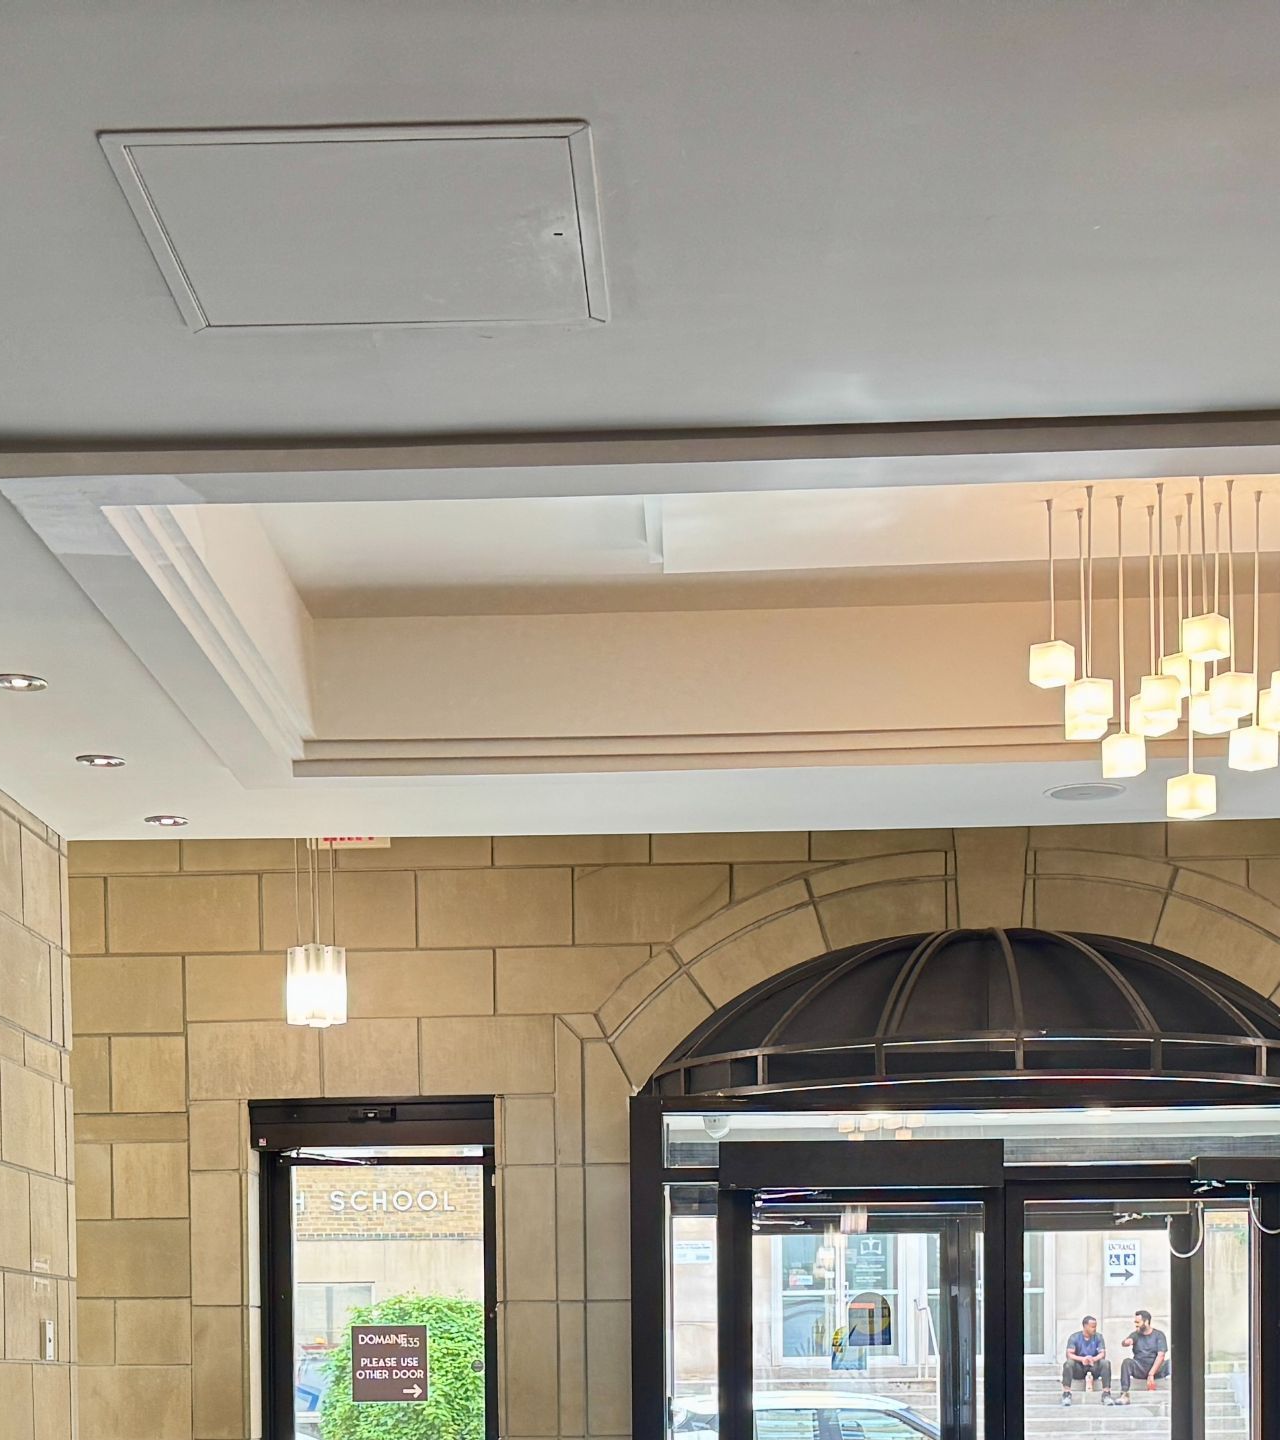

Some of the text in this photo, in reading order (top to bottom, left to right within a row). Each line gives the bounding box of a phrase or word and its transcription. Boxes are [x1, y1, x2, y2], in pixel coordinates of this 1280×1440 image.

[330, 1190, 456, 1212] SCHOOL
[360, 1357, 419, 1367] PLEASE USE
[355, 1369, 424, 1380] OTHER DOOR
